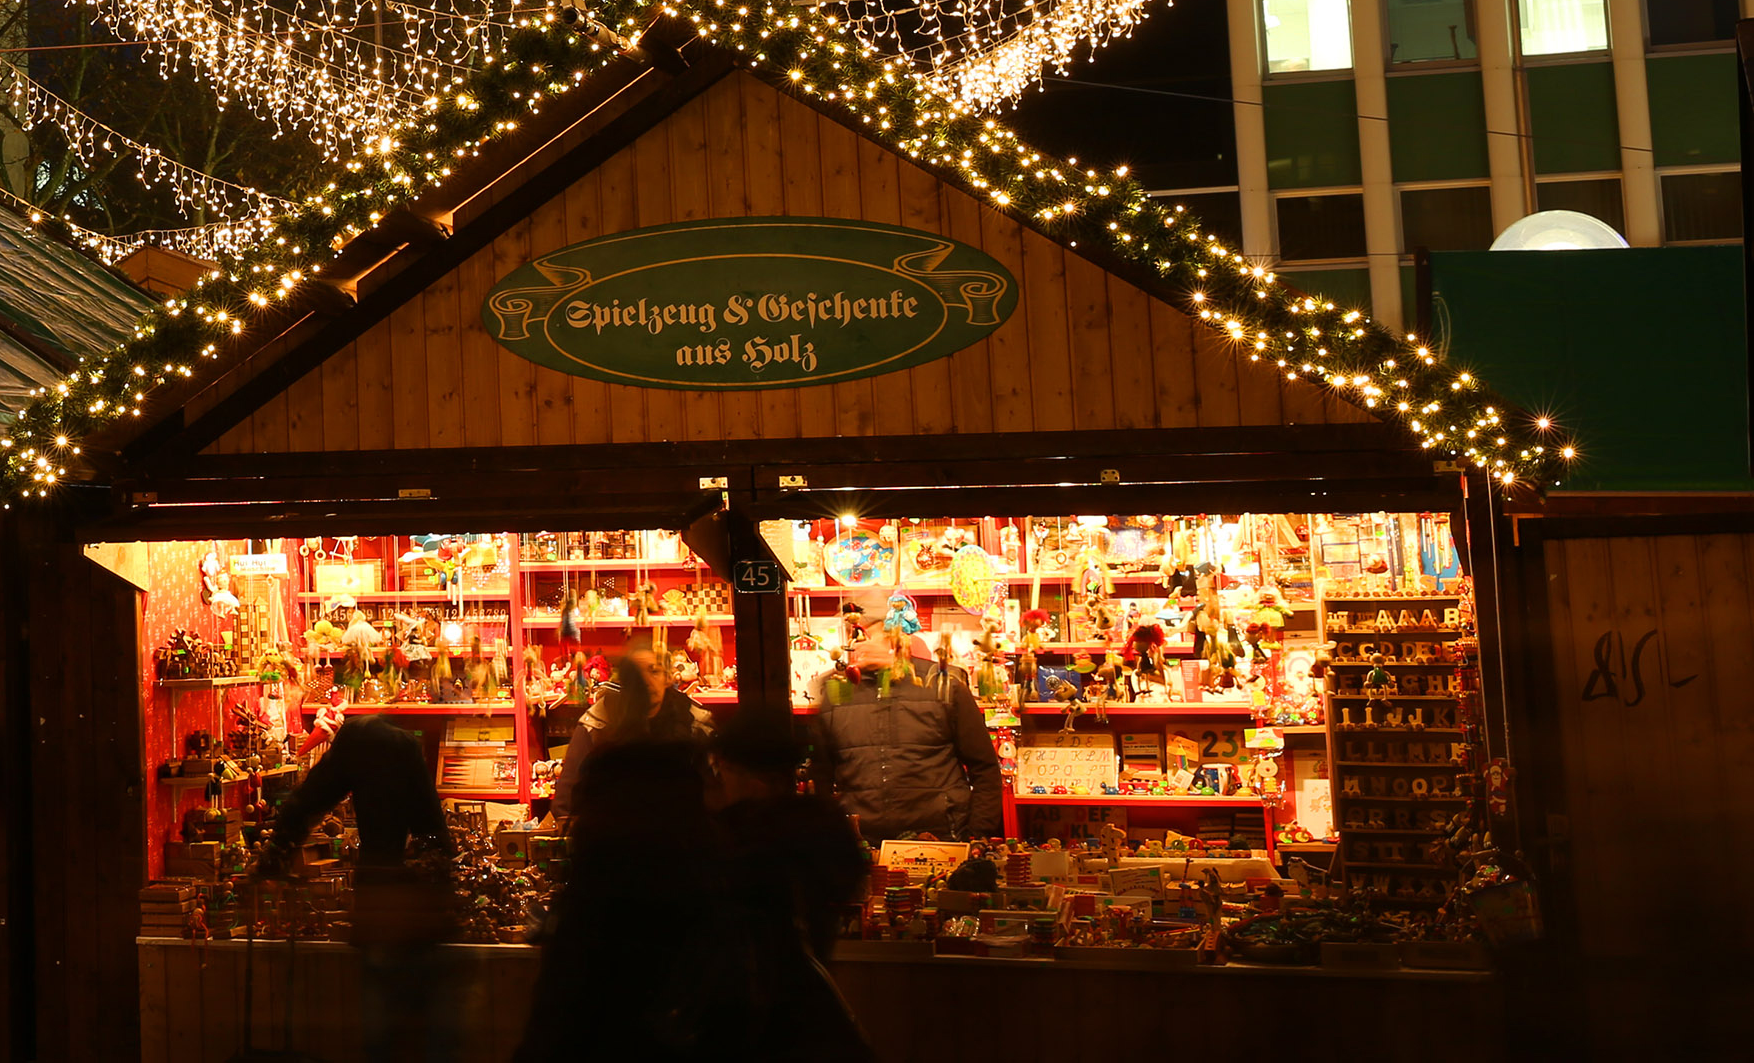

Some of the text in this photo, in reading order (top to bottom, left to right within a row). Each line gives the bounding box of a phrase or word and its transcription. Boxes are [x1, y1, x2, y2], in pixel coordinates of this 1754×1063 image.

[565, 295, 717, 337] Spielzeug
[723, 294, 753, 327] &
[676, 333, 818, 373] aus Holz
[741, 566, 770, 586] 45
[1202, 730, 1238, 758] 23
